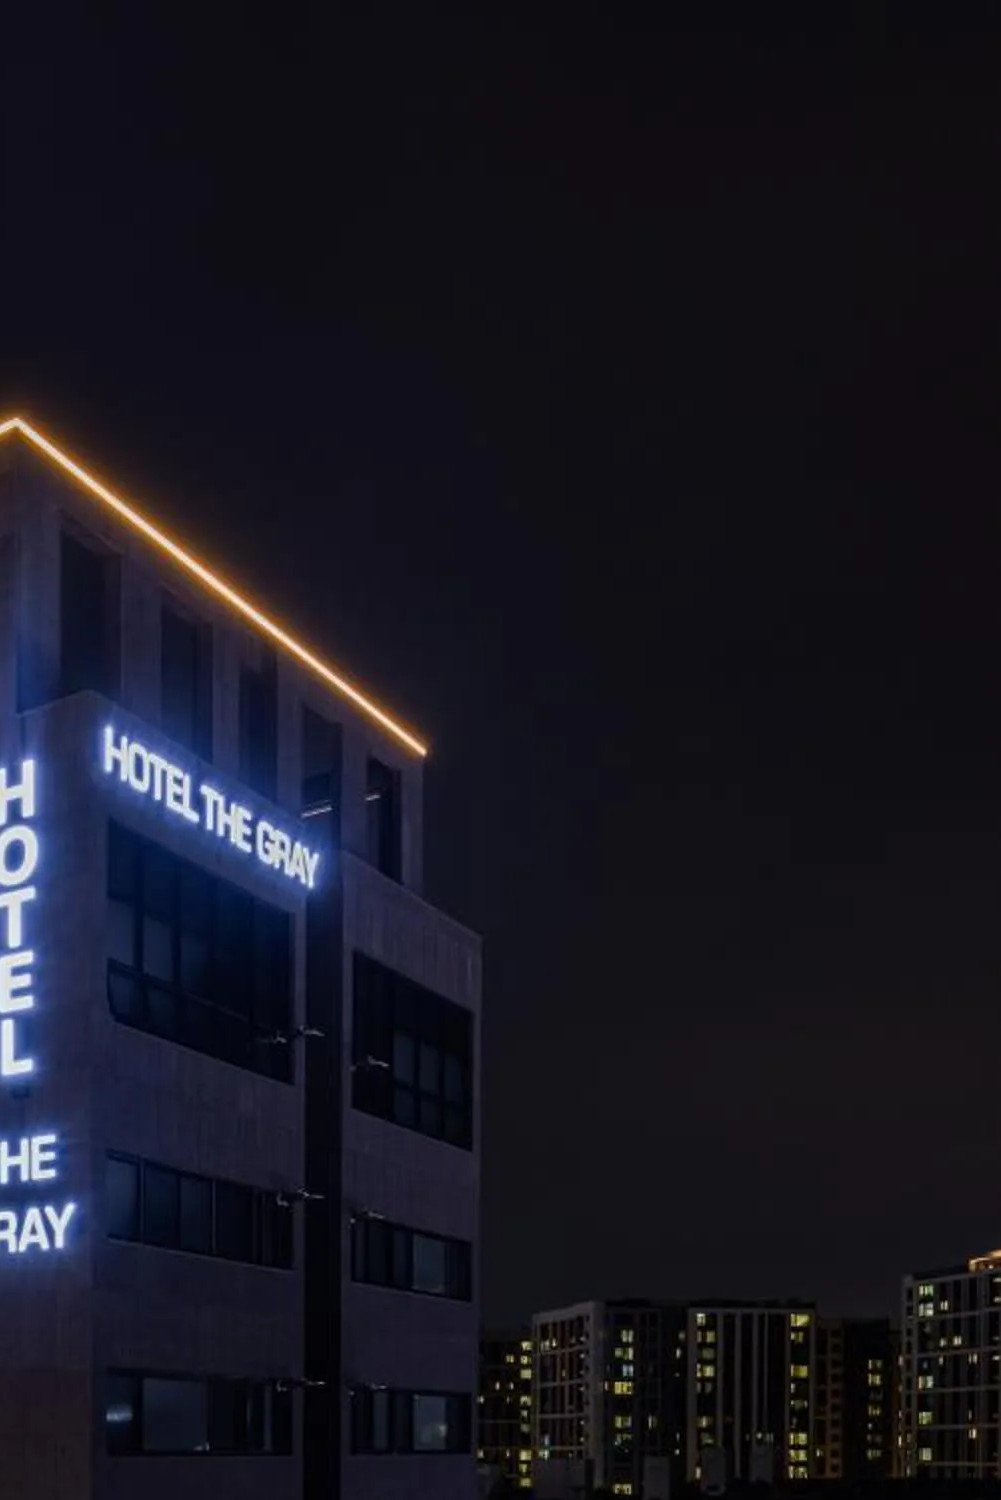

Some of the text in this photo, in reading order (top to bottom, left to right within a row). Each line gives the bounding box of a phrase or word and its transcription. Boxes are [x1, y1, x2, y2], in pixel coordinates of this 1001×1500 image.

[104, 726, 321, 889] HOTEL THE GRAY
